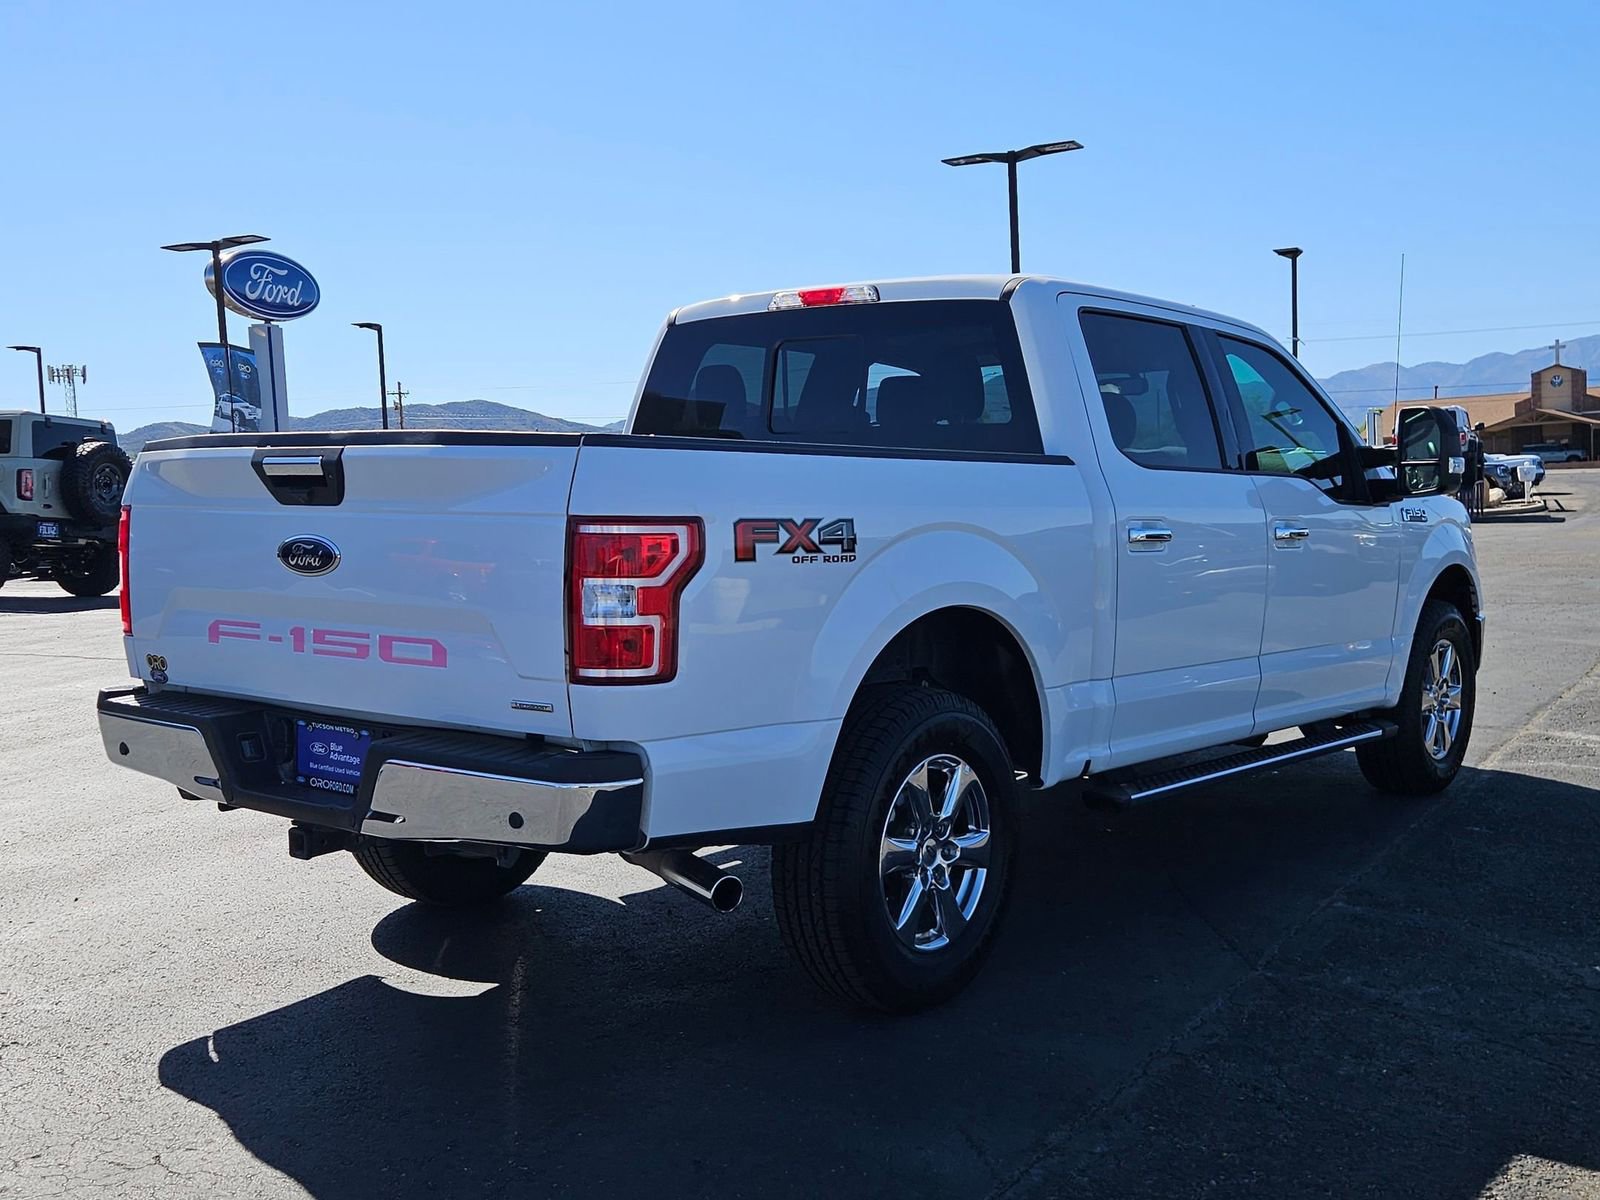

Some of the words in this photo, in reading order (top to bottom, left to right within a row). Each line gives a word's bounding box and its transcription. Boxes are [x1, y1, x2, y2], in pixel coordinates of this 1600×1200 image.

[245, 263, 303, 306] Ford
[733, 518, 857, 562] FX4
[288, 543, 323, 567] Ford
[791, 555, 819, 564] OFF
[823, 555, 857, 563] ROAD
[207, 618, 448, 669] F-150
[311, 722, 334, 731] TUCSON
[335, 725, 355, 734] METRO
[330, 742, 343, 752] Blue
[330, 752, 360, 765] Advantage
[318, 764, 334, 772] Certified
